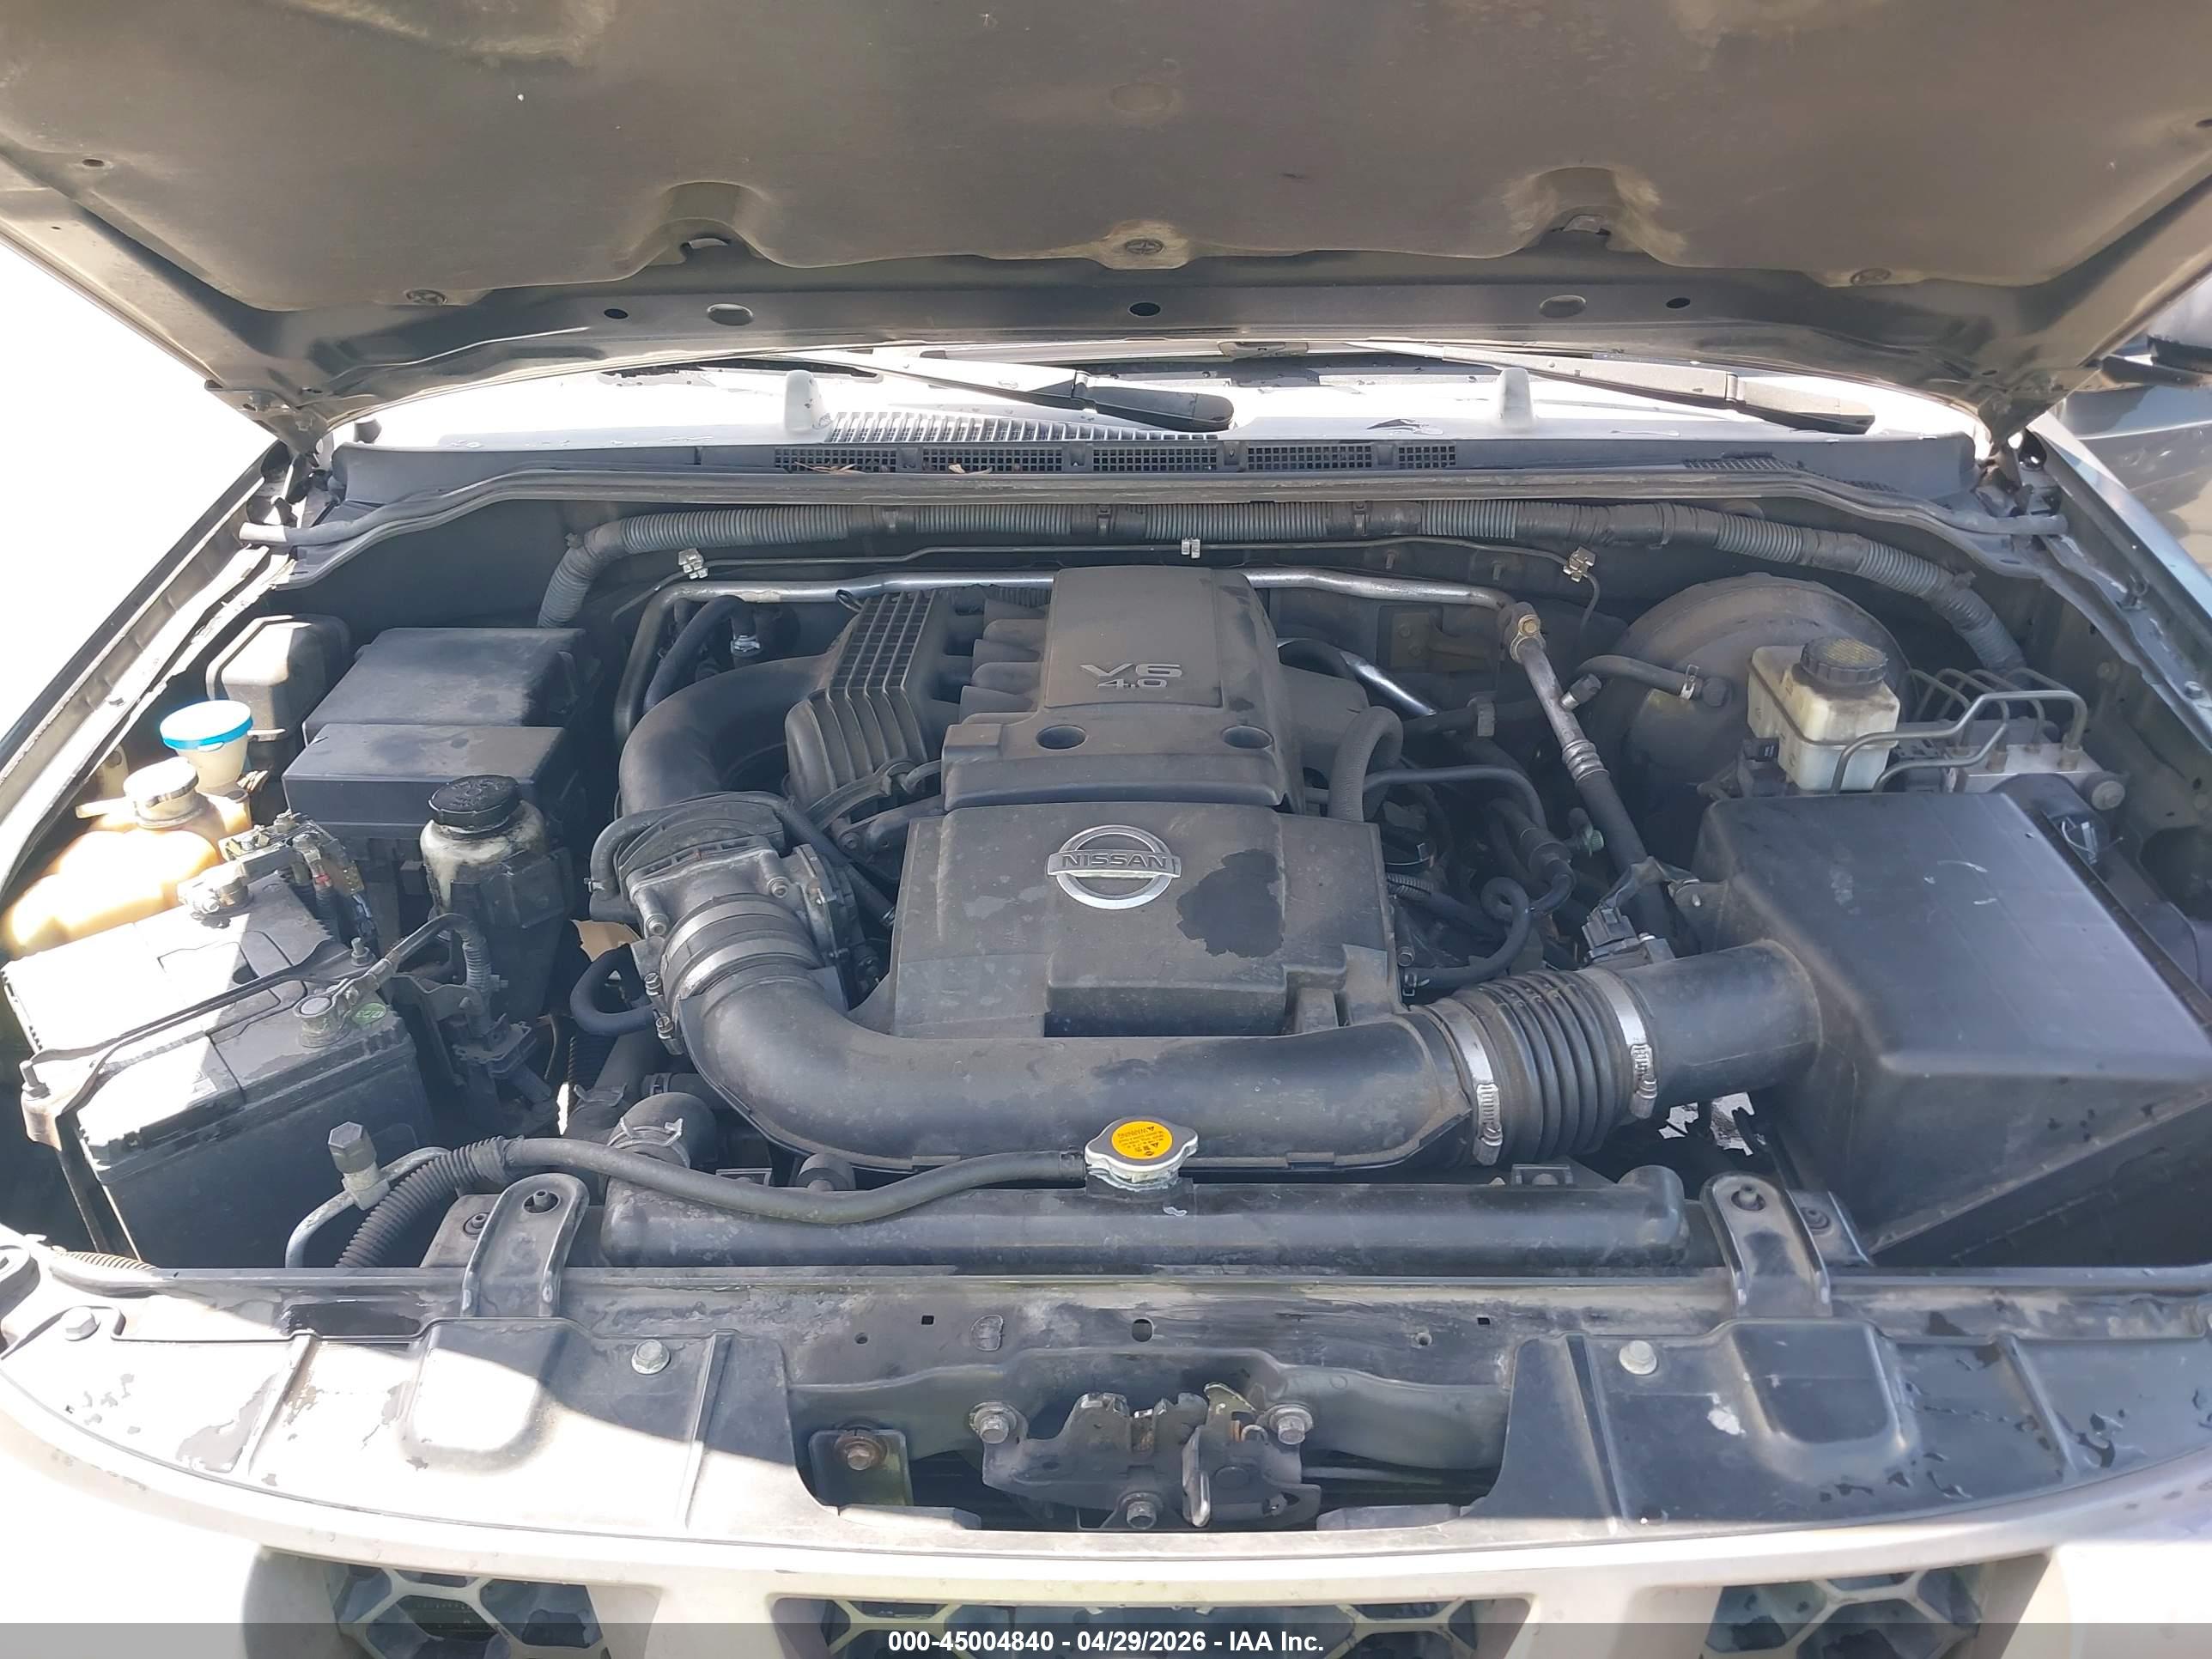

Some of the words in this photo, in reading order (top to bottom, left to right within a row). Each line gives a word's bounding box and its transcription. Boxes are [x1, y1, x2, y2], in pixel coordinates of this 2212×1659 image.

[1079, 662, 1182, 678] V6
[1097, 678, 1169, 689] 4.0
[1062, 853, 1168, 869] NISSAN
